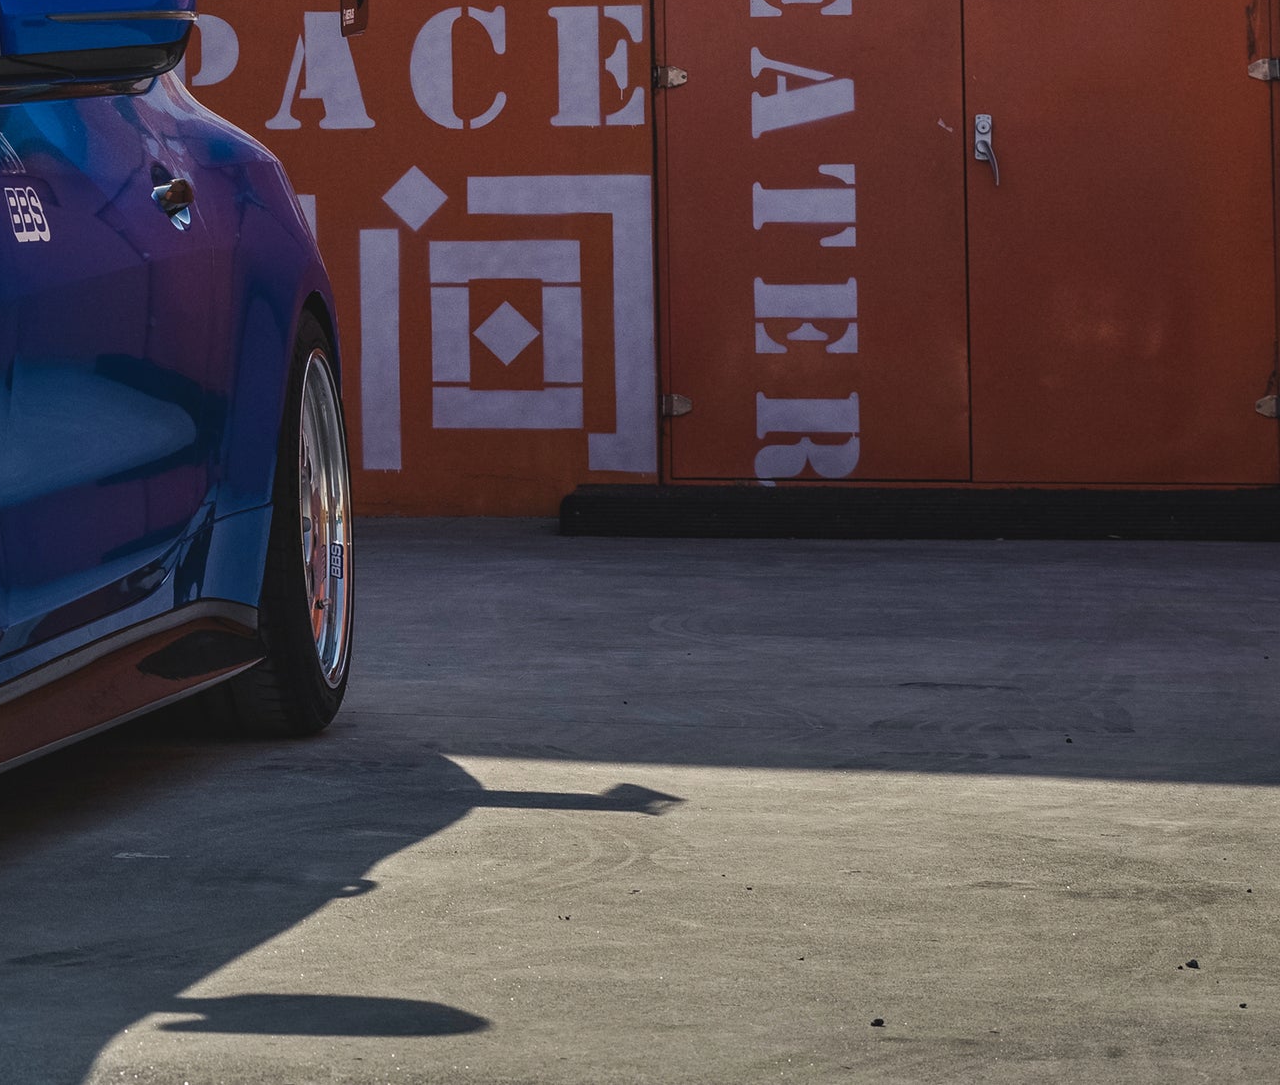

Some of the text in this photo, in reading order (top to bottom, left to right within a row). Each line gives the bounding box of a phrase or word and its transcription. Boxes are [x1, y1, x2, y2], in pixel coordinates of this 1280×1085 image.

[173, 5, 646, 130] PACE
[3, 185, 52, 243] BBS
[330, 543, 343, 579] BBS
